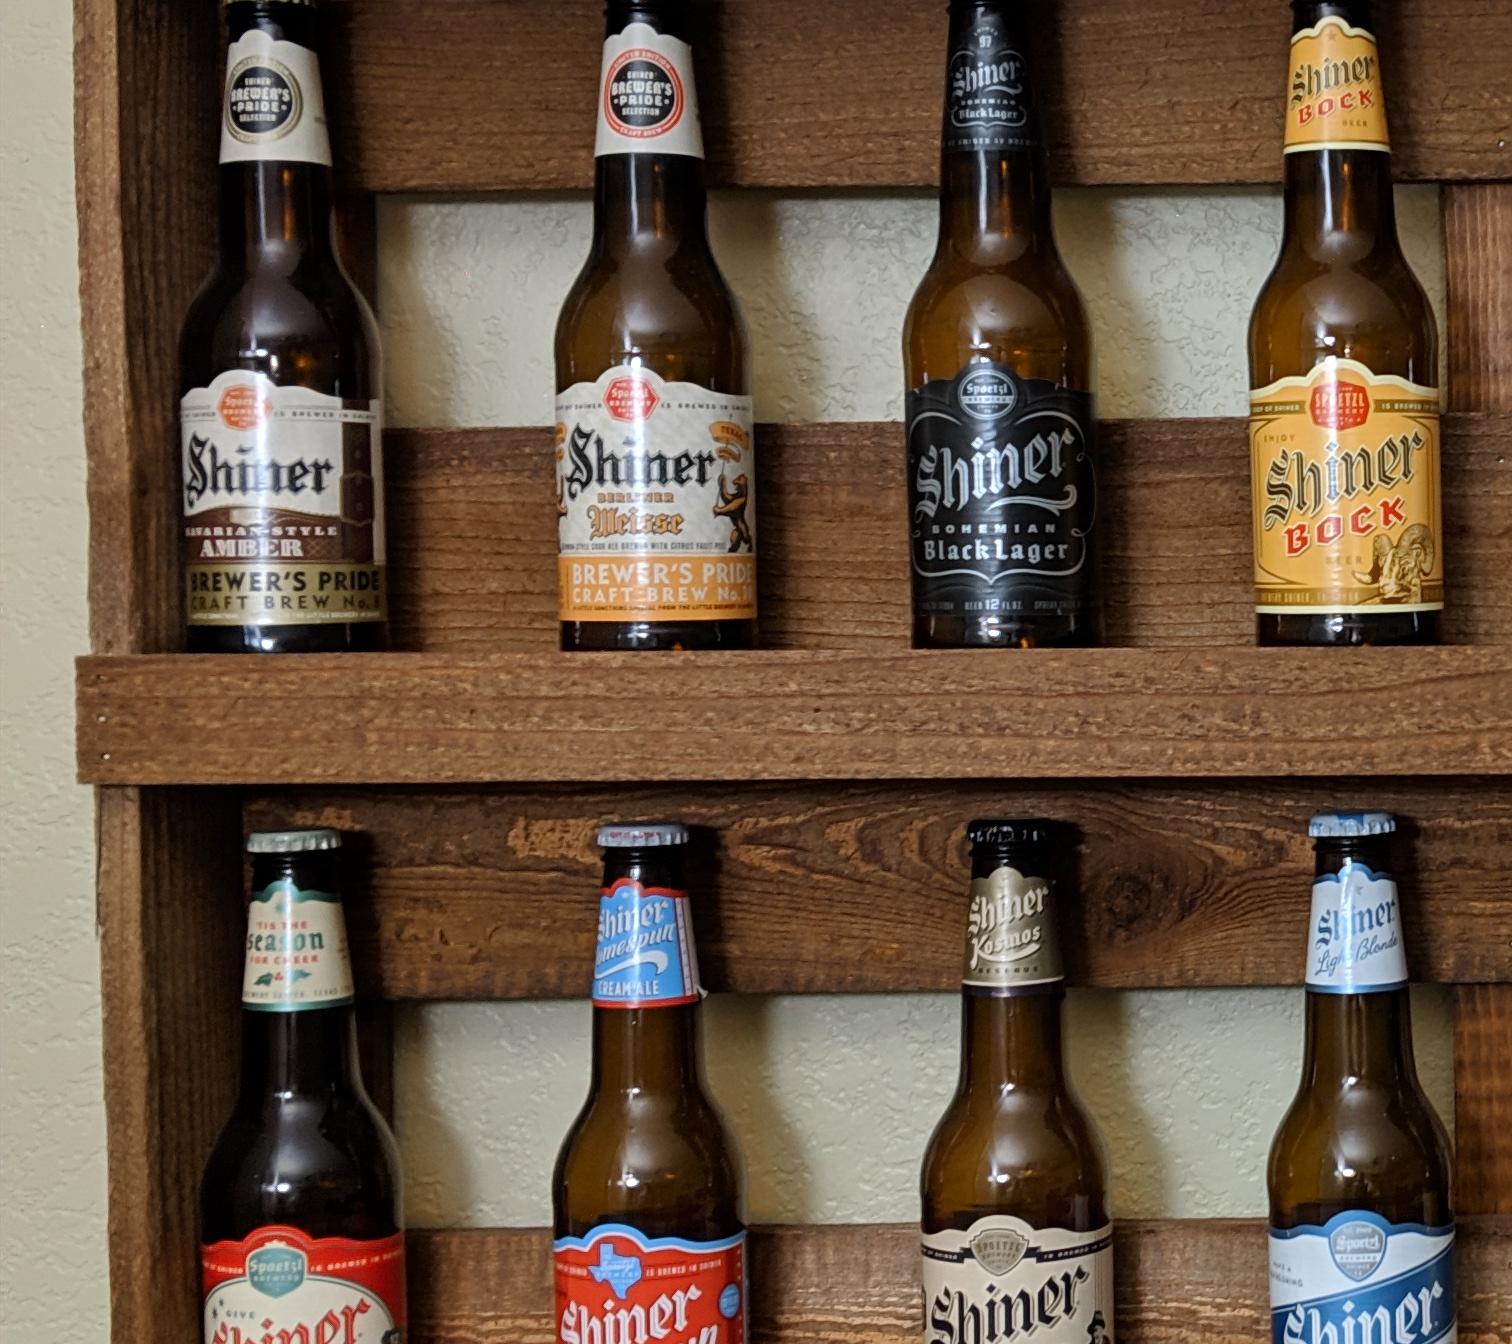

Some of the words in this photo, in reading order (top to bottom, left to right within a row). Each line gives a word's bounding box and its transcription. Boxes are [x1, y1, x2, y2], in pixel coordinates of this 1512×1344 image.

[612, 81, 672, 95] BREWER'S
[619, 95, 663, 106] PRIDE
[1298, 90, 1374, 124] BOCK
[186, 431, 334, 508] Shiner
[565, 423, 716, 501] Shiner
[915, 427, 1076, 521] Shiner
[1264, 431, 1423, 530] Shiner
[932, 524, 1056, 534] BOHEMIAN
[1284, 496, 1405, 555] BOCK
[200, 539, 303, 557] AMBER
[572, 587, 633, 603] CRAFT
[647, 587, 707, 602] BREW
